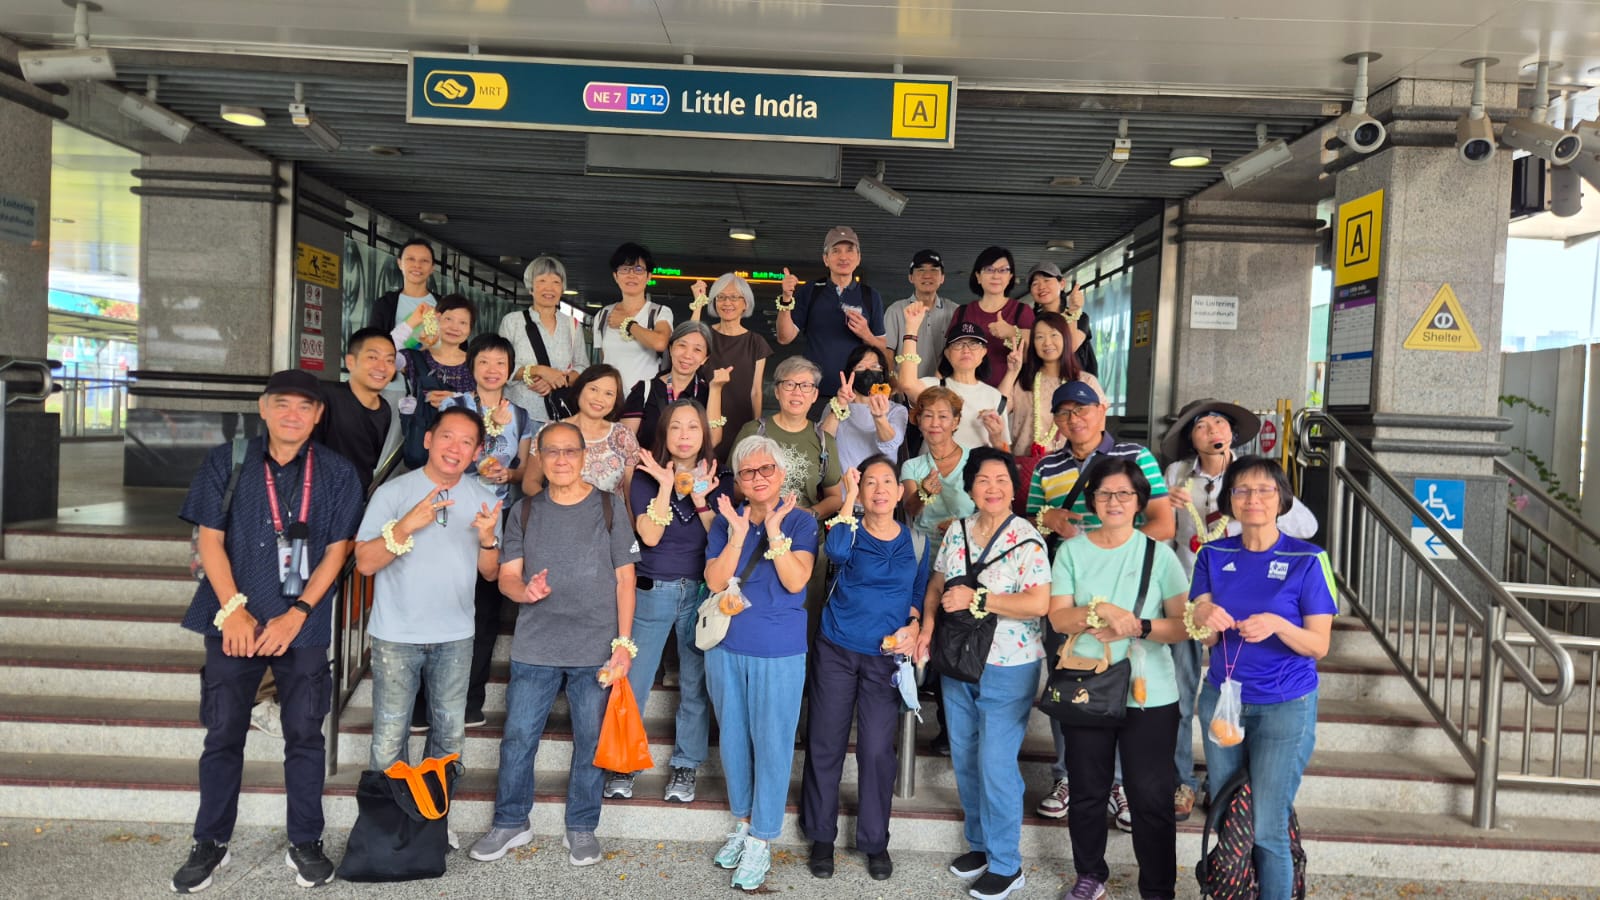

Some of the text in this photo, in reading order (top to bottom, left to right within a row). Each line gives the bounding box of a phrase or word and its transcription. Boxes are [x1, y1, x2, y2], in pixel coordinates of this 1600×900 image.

[479, 86, 501, 96] MRT
[593, 91, 622, 104] NE 7
[630, 92, 664, 106] DT 12
[681, 89, 818, 119] Little India
[911, 100, 928, 122] A
[1350, 223, 1364, 257] A
[1422, 331, 1463, 343] Shelter
